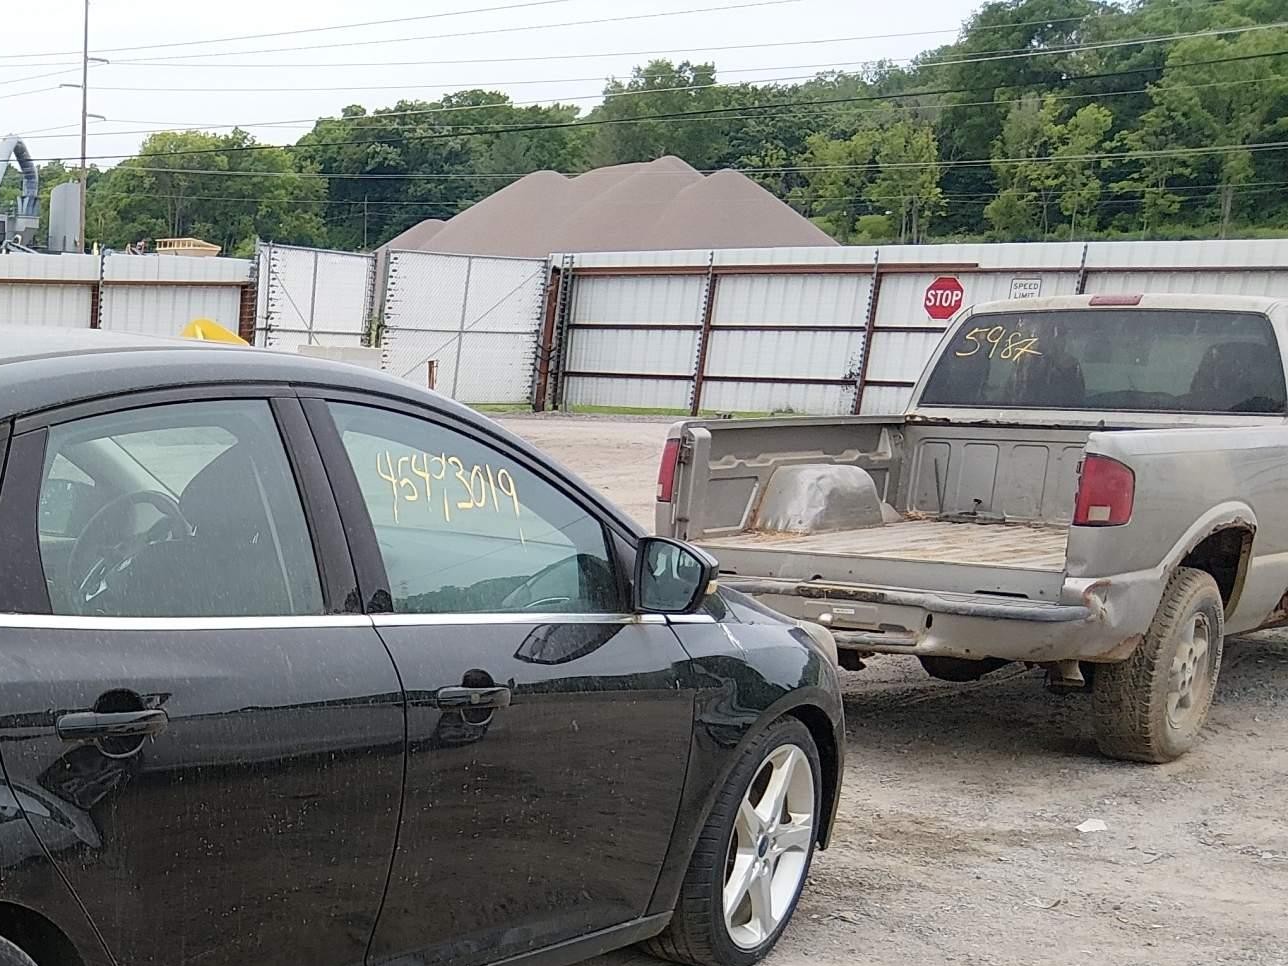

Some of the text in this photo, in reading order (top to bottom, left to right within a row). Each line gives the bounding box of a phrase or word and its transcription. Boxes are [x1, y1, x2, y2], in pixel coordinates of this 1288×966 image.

[1013, 282, 1040, 291] SPEED
[925, 289, 962, 308] STOP
[1013, 292, 1036, 300] LIMIT
